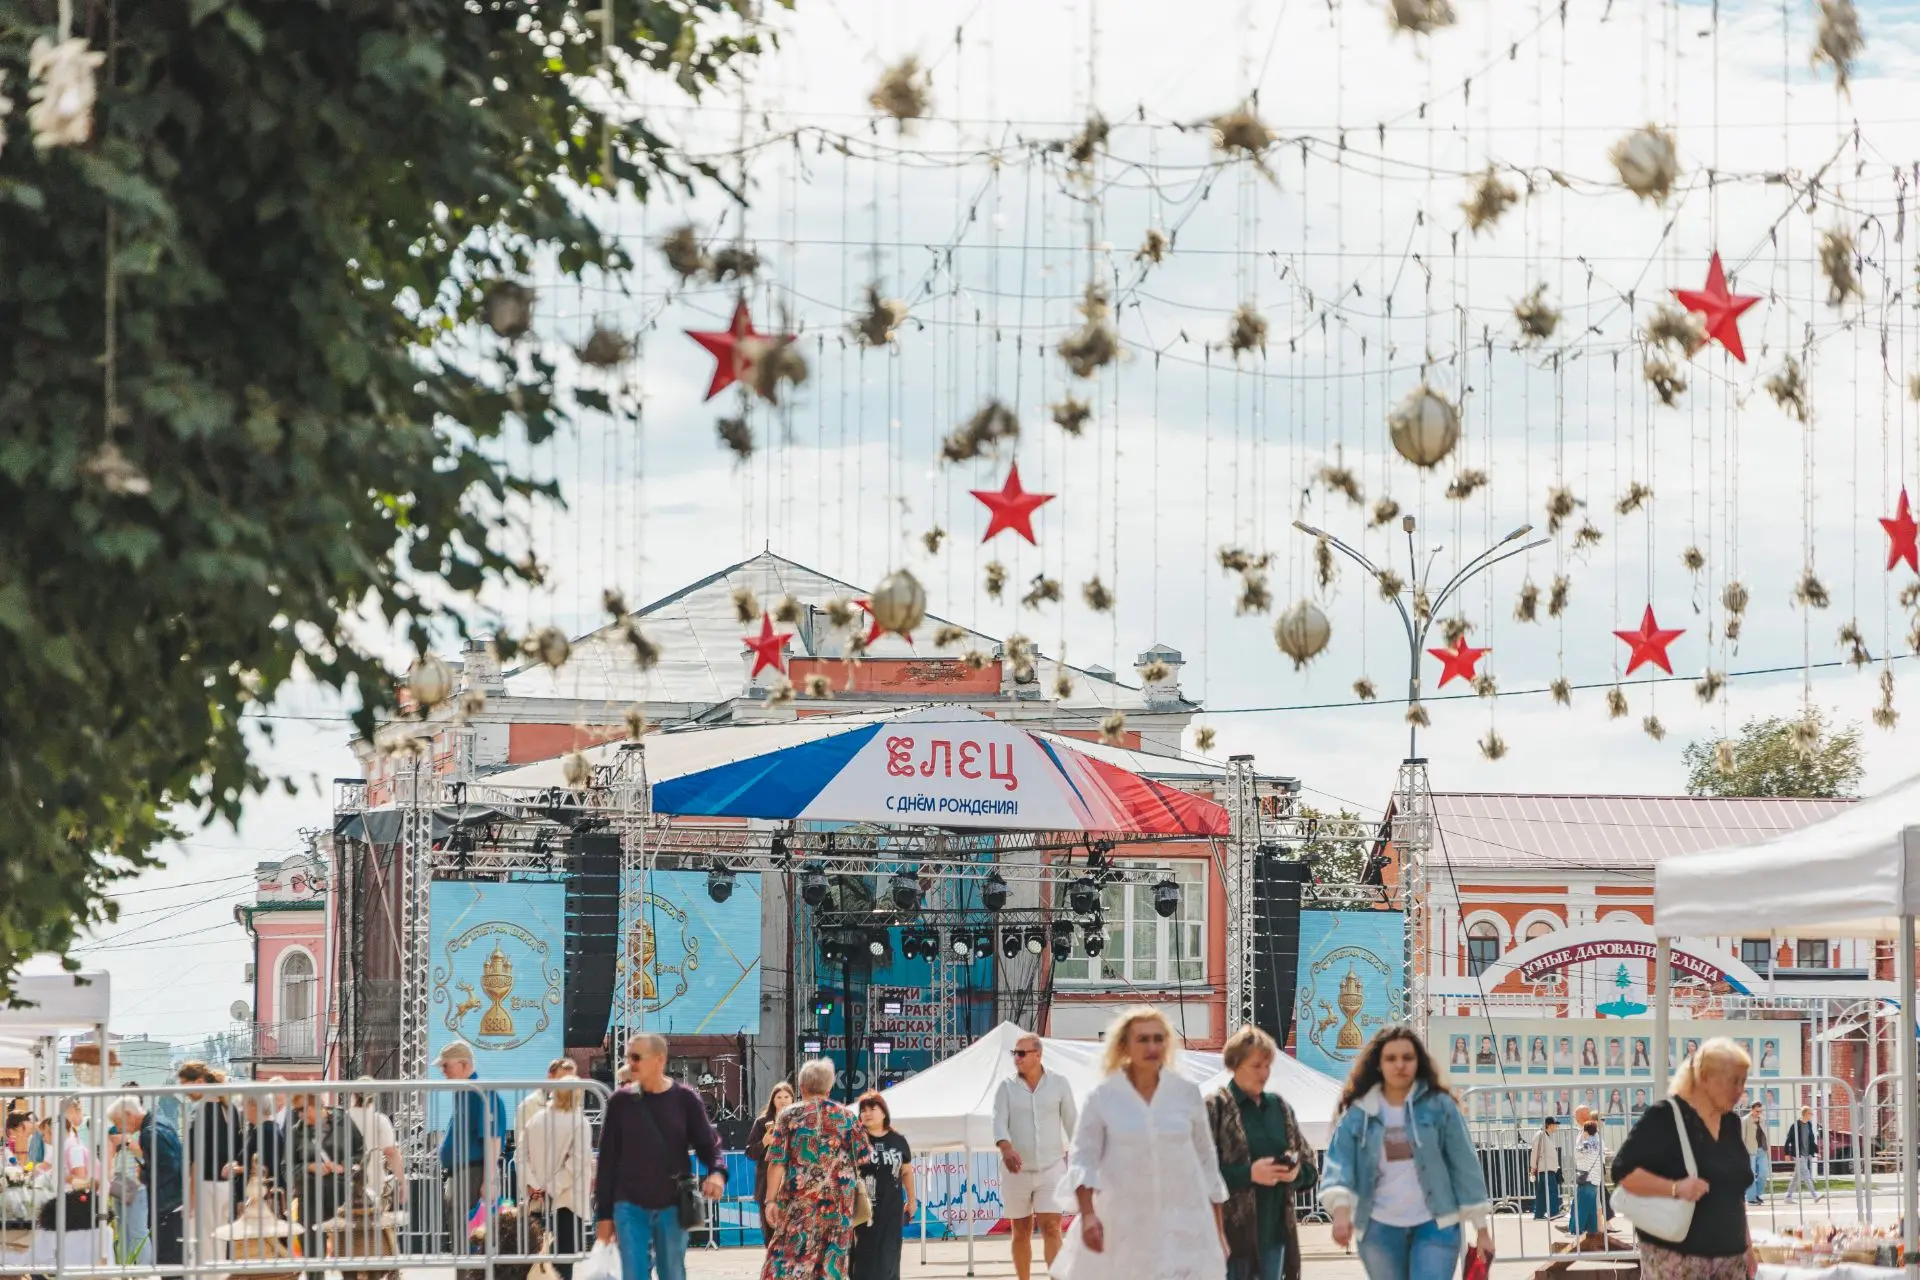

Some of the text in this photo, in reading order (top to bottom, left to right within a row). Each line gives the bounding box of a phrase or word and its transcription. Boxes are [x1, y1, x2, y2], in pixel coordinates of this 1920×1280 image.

[886, 736, 1018, 792] ЕЛЕЦ
[886, 793, 1018, 815] С ДНЁМ РОЖДЕНИЯ!
[1522, 943, 1719, 982] ЮНЫЕ ДАРОВАНИ ЕЛЬЦА
